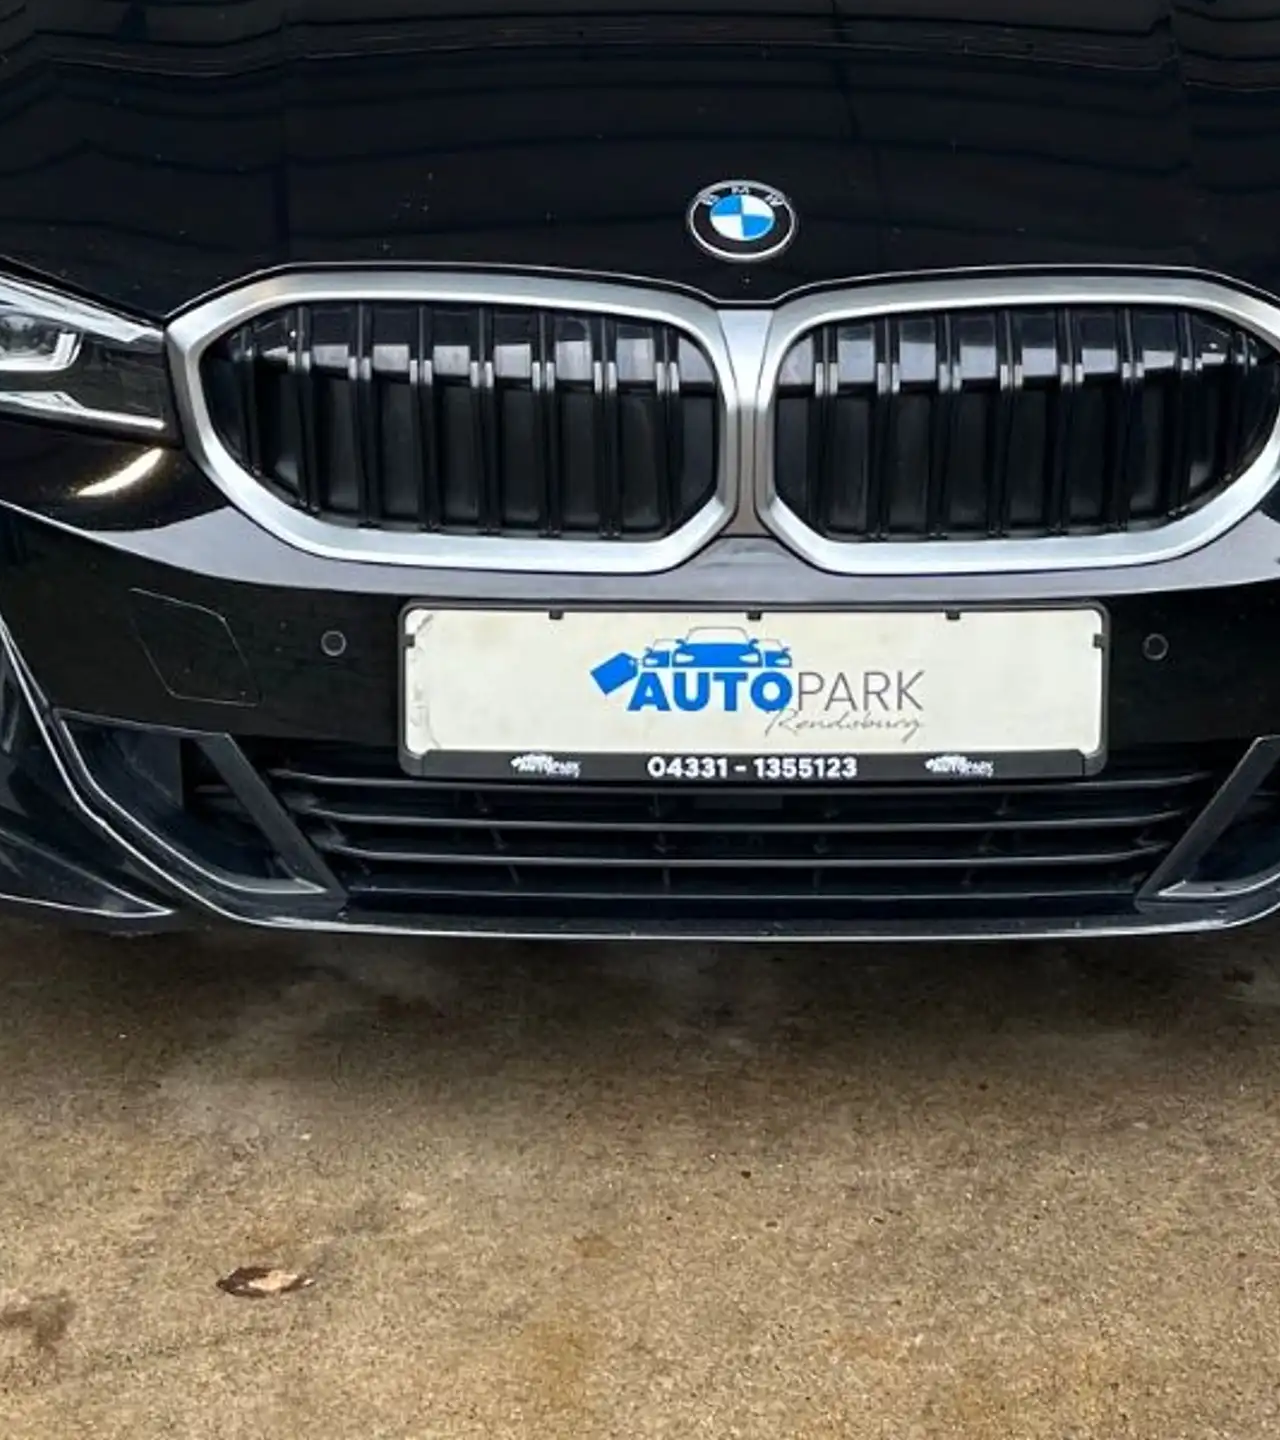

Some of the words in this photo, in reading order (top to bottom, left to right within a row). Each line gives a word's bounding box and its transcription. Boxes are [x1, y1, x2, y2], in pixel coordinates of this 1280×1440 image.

[627, 671, 925, 711] AUTOPARK
[647, 757, 728, 777] 04331
[753, 757, 858, 777] 1355123
